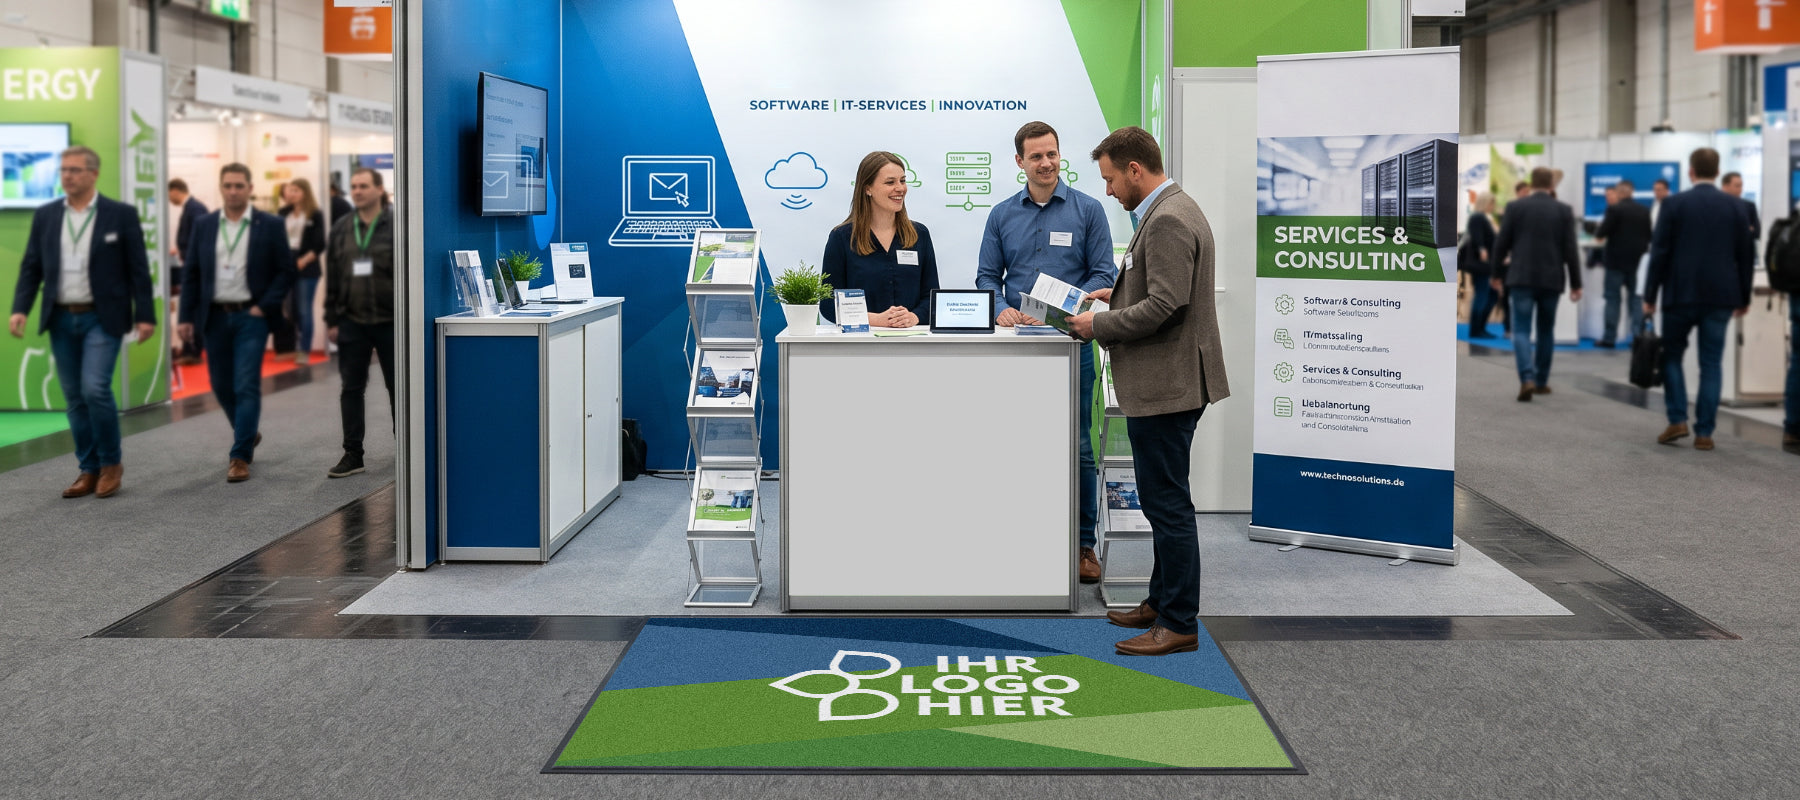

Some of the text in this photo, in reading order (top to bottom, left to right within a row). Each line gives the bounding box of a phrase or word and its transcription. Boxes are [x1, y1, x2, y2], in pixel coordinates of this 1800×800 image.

[4, 68, 102, 101] ERGY
[749, 99, 829, 111] SOFTWARE
[841, 99, 927, 111] IT-SERVICES
[939, 99, 1027, 111] INNOVATION
[1274, 226, 1409, 245] SERVICES &
[1274, 250, 1426, 271] CONSULTING
[1303, 308, 1336, 316] Software
[1350, 297, 1401, 309] Consulting
[1302, 364, 1402, 380] Services & Consulting
[1299, 470, 1405, 487] www.technosolutions.de
[936, 655, 1044, 673] IHR
[900, 674, 1081, 694] LOGO
[917, 695, 1073, 716] HIER
